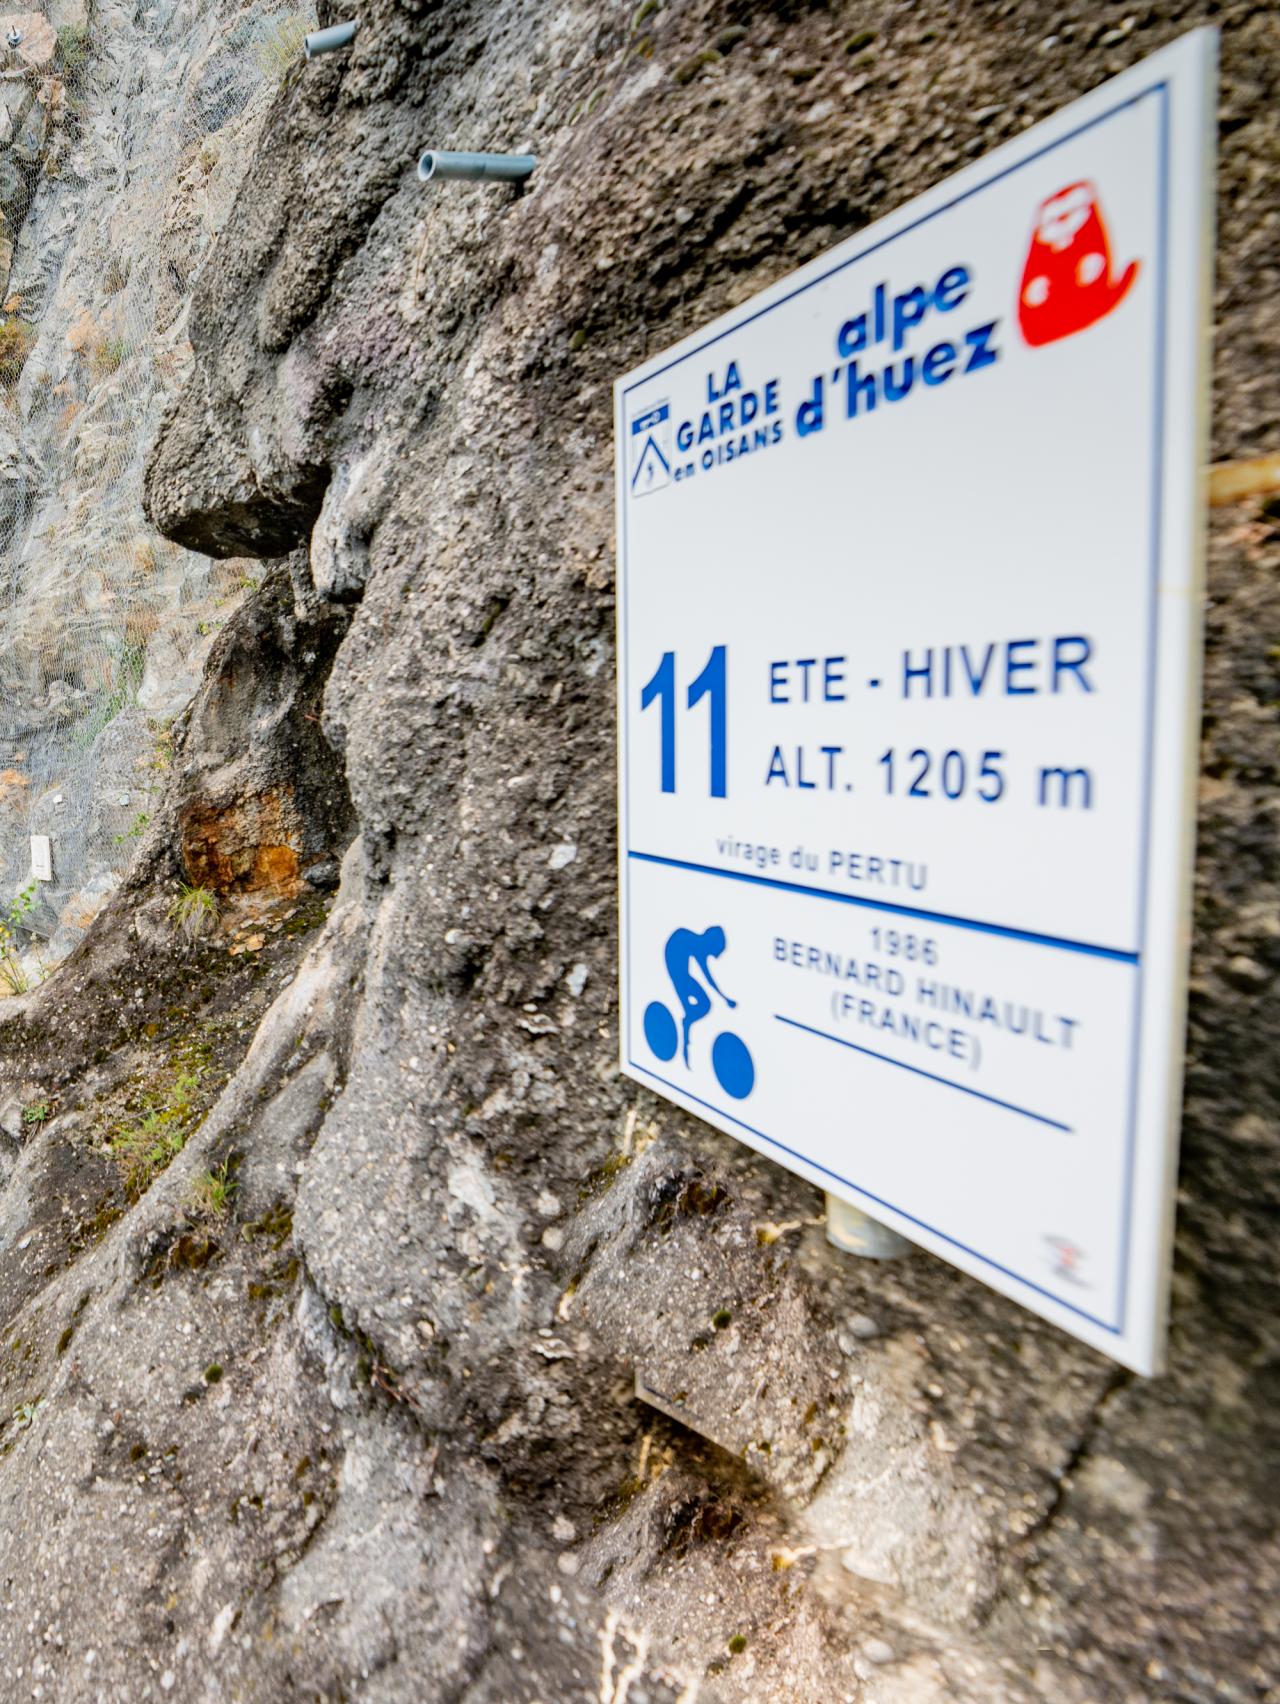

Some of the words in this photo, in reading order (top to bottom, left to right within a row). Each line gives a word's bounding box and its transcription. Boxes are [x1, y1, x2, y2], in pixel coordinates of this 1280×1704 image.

[836, 261, 972, 359] alpe
[705, 359, 744, 405] LA
[794, 317, 1004, 440] d'huez
[673, 462, 696, 483] en
[700, 419, 784, 473] OISANS
[674, 377, 782, 454] GARDE
[769, 656, 848, 704] ETE
[902, 634, 1097, 699] HIVER
[639, 643, 729, 800] 11
[764, 745, 853, 793] ALT.
[878, 747, 1006, 804] 1205
[1037, 766, 1095, 810] m
[716, 835, 781, 869] virage
[788, 844, 820, 874] du
[829, 850, 929, 891] PERTU
[869, 927, 939, 967] 1986
[773, 937, 905, 998] BERNARD
[916, 971, 1082, 1051] HINAULT
[830, 990, 984, 1071] (FRANCE)
